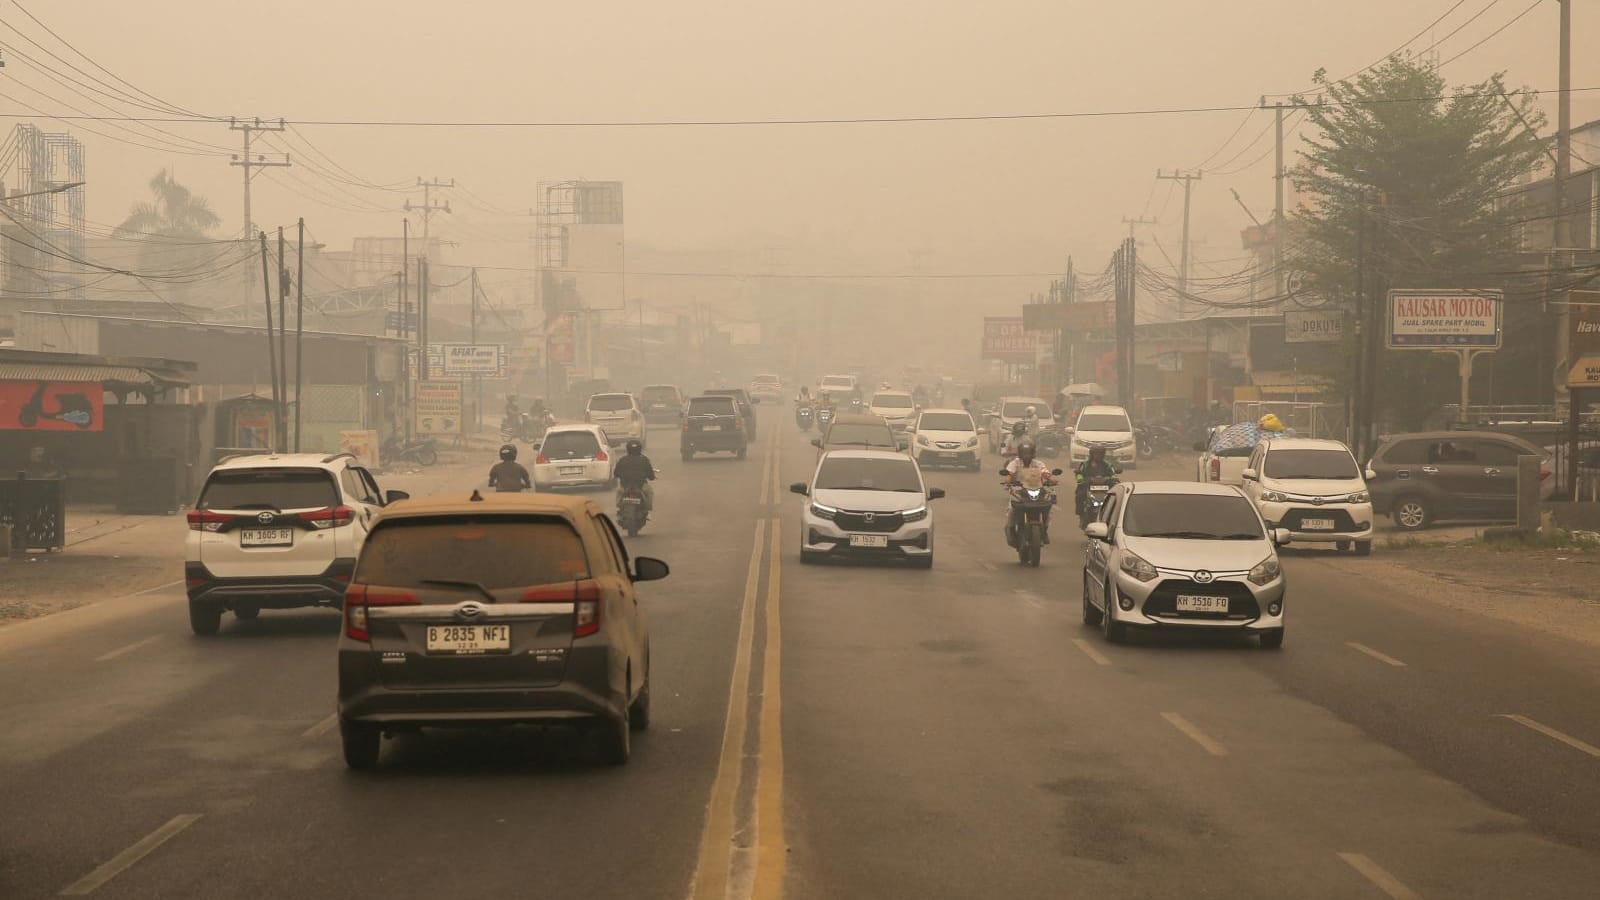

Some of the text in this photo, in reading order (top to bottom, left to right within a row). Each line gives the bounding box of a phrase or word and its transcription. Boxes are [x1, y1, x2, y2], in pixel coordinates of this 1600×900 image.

[1397, 298, 1493, 317] KAUSAR MOTOR
[1402, 319, 1486, 328] JUAL SPARE PART MOBIL
[243, 530, 290, 540] KH 1605 RF
[1177, 597, 1188, 605] KH
[430, 627, 507, 641] B 2835 NFI
